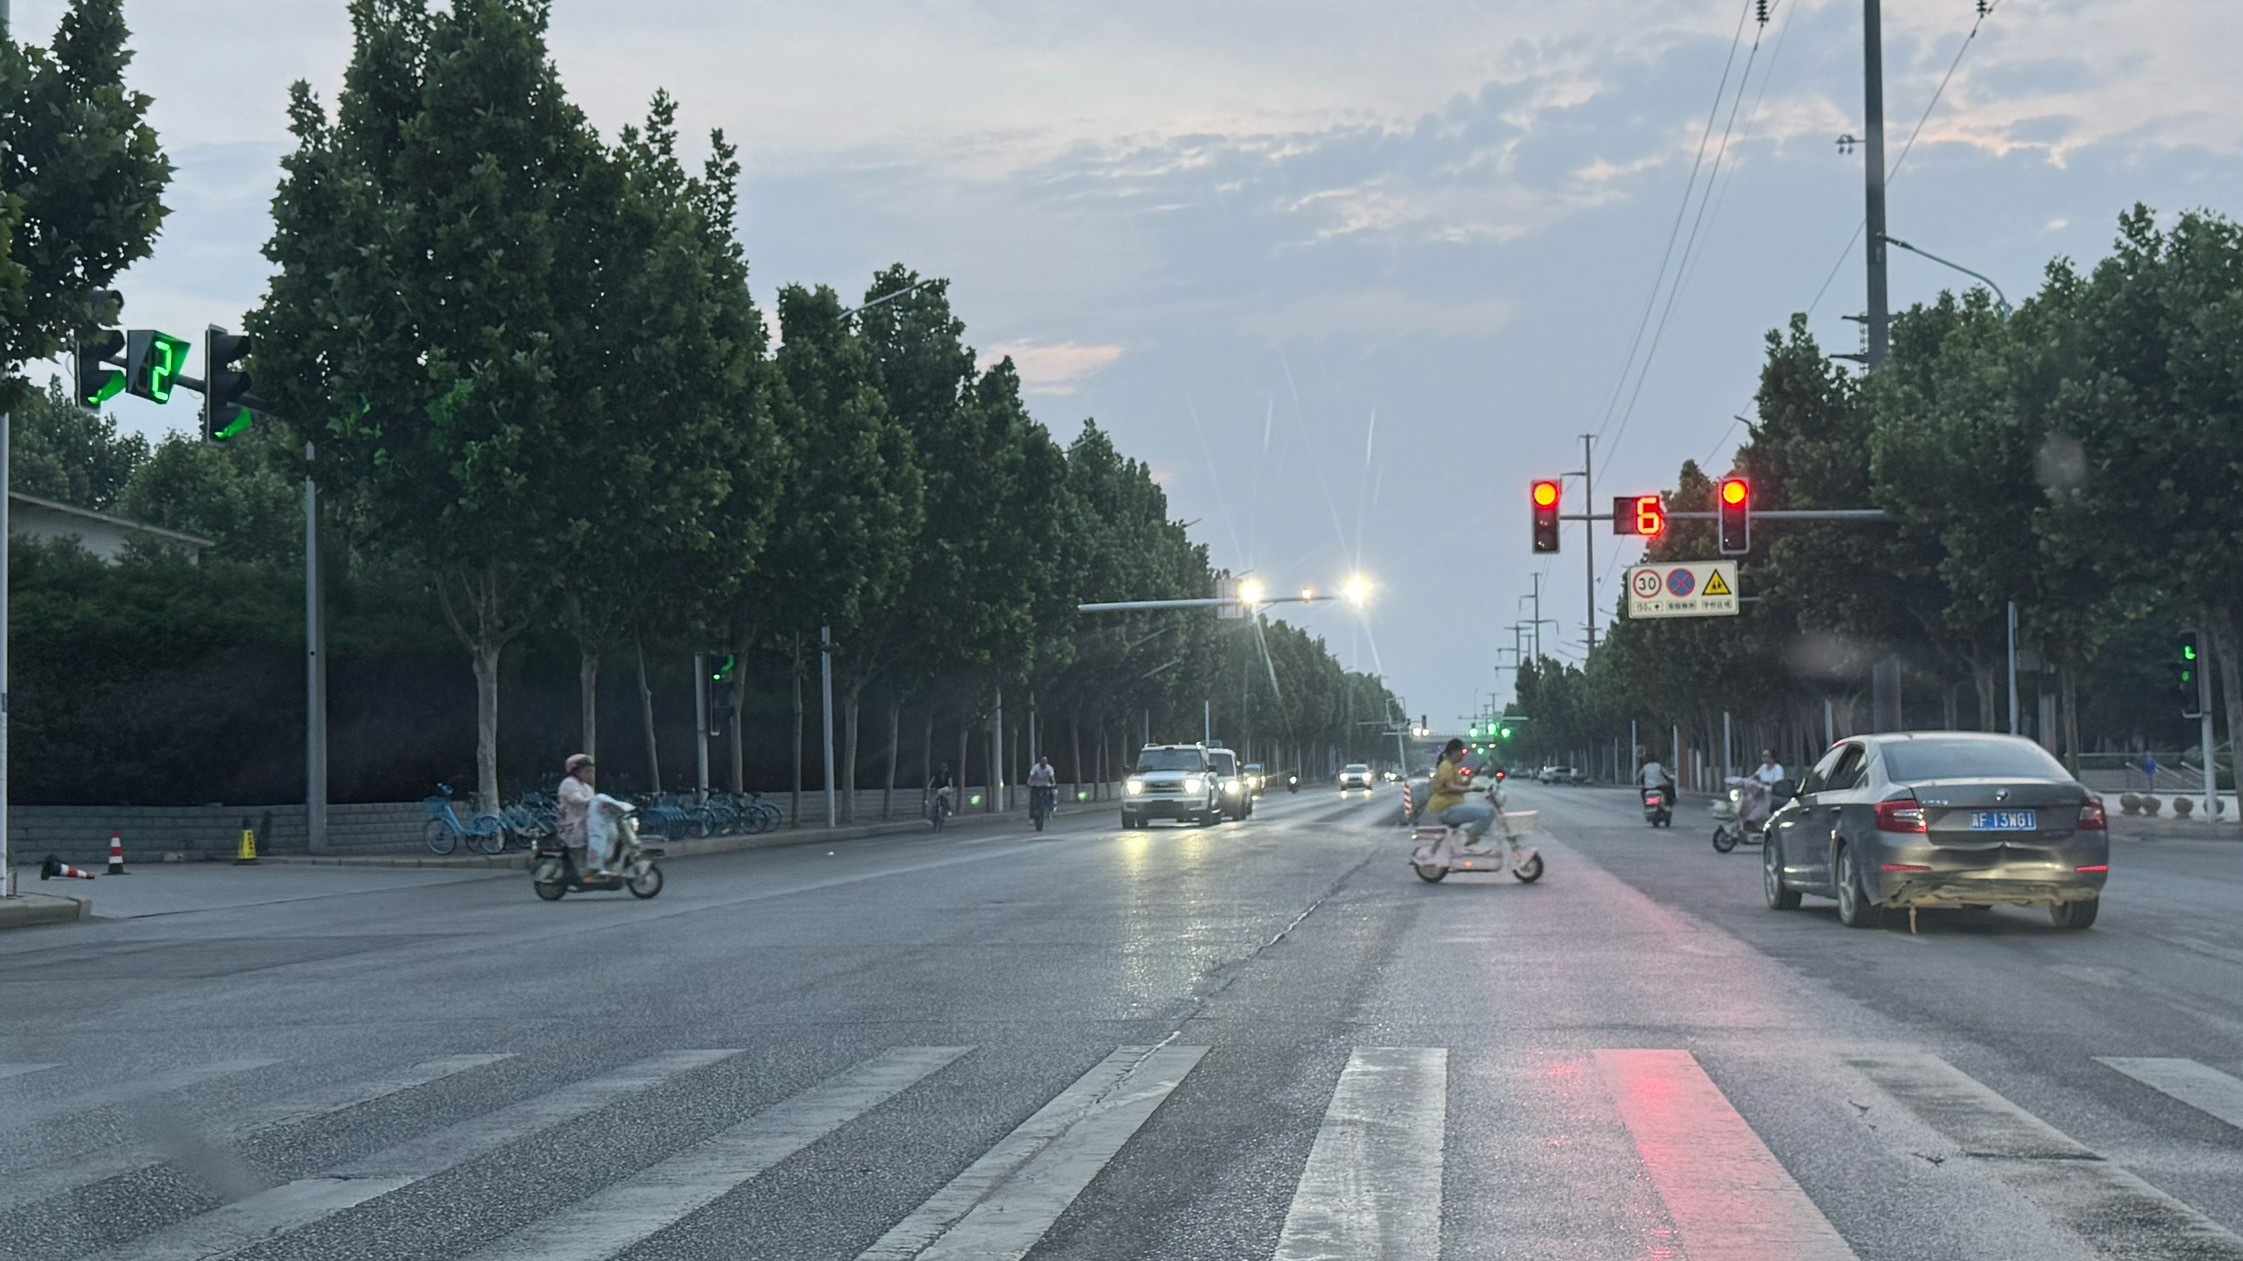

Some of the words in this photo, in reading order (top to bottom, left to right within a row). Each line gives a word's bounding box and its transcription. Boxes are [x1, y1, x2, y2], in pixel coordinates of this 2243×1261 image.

[152, 341, 172, 400] 2
[1637, 497, 1660, 534] 6
[1638, 577, 1657, 591] 30
